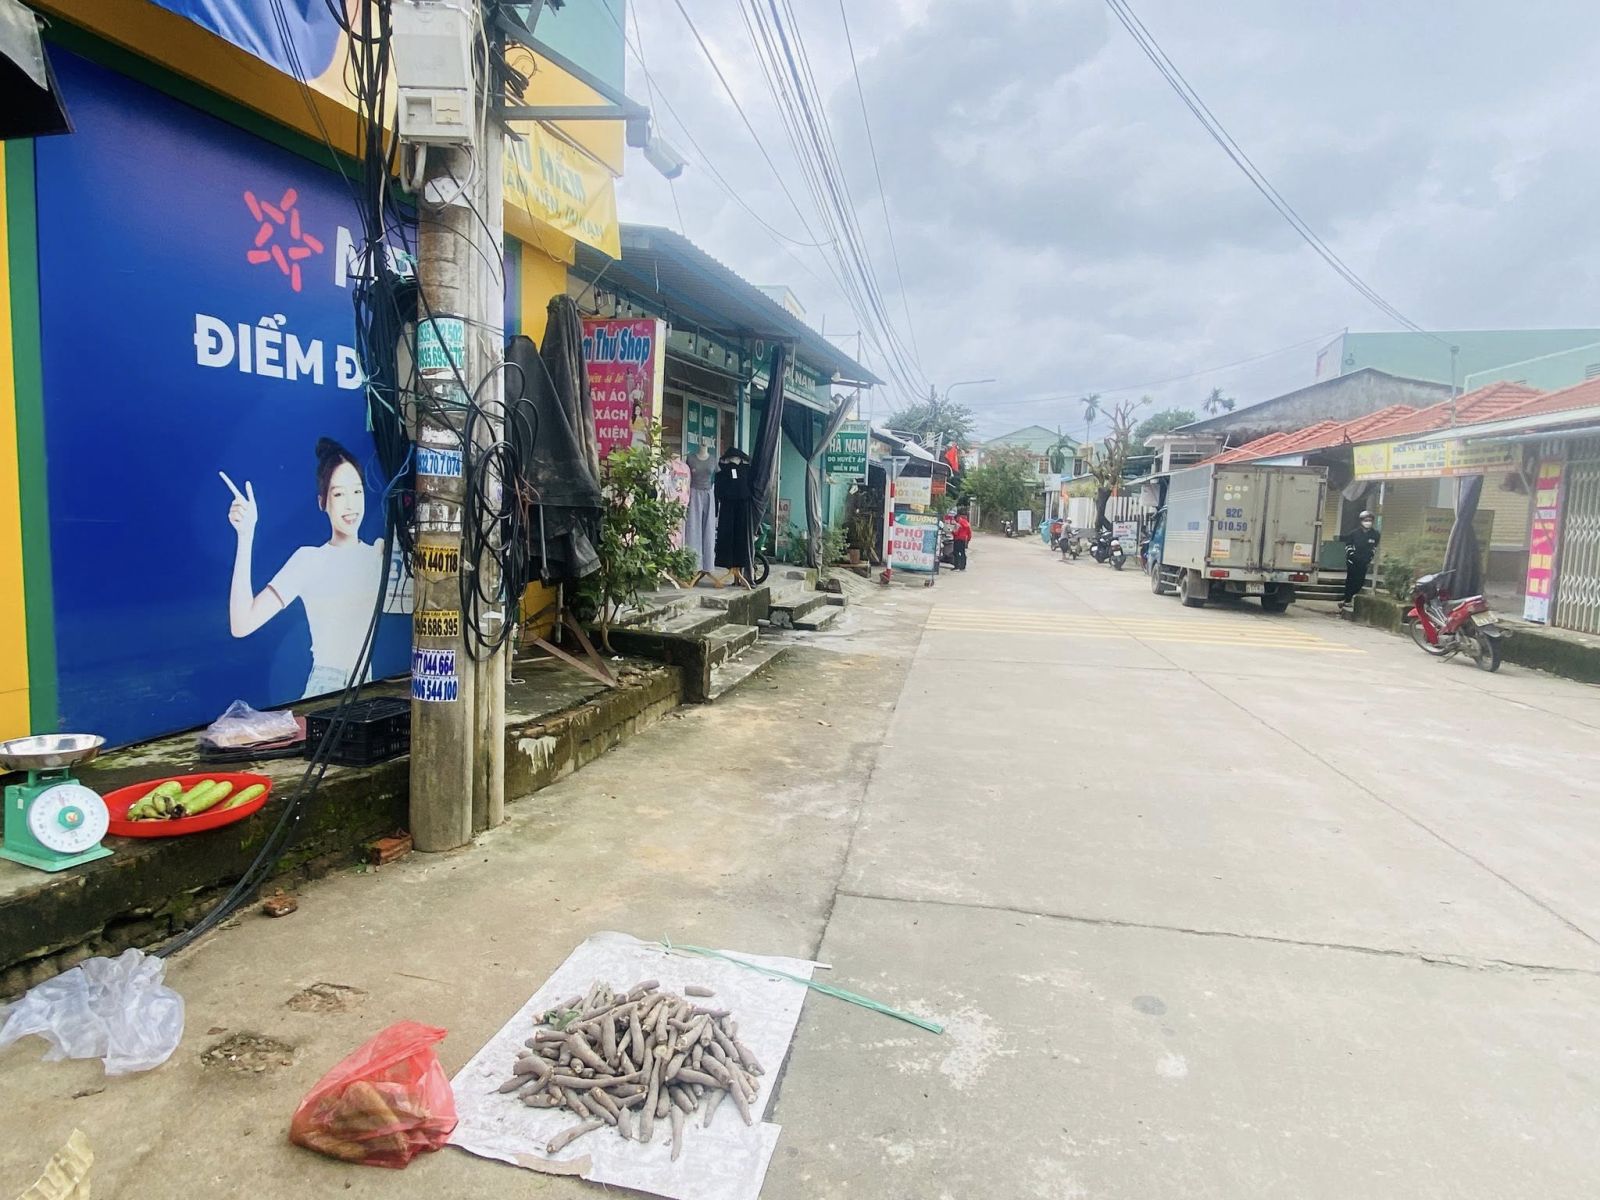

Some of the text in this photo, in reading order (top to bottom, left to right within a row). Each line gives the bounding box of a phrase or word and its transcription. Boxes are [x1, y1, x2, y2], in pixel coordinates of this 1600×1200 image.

[194, 313, 324, 385] ĐIỂM
[619, 323, 651, 370] Shop
[610, 387, 627, 402] ÁO
[594, 406, 628, 420] XÁCH
[599, 424, 629, 441] KIỆN
[845, 438, 866, 453] NAM
[1226, 508, 1243, 518] 92C
